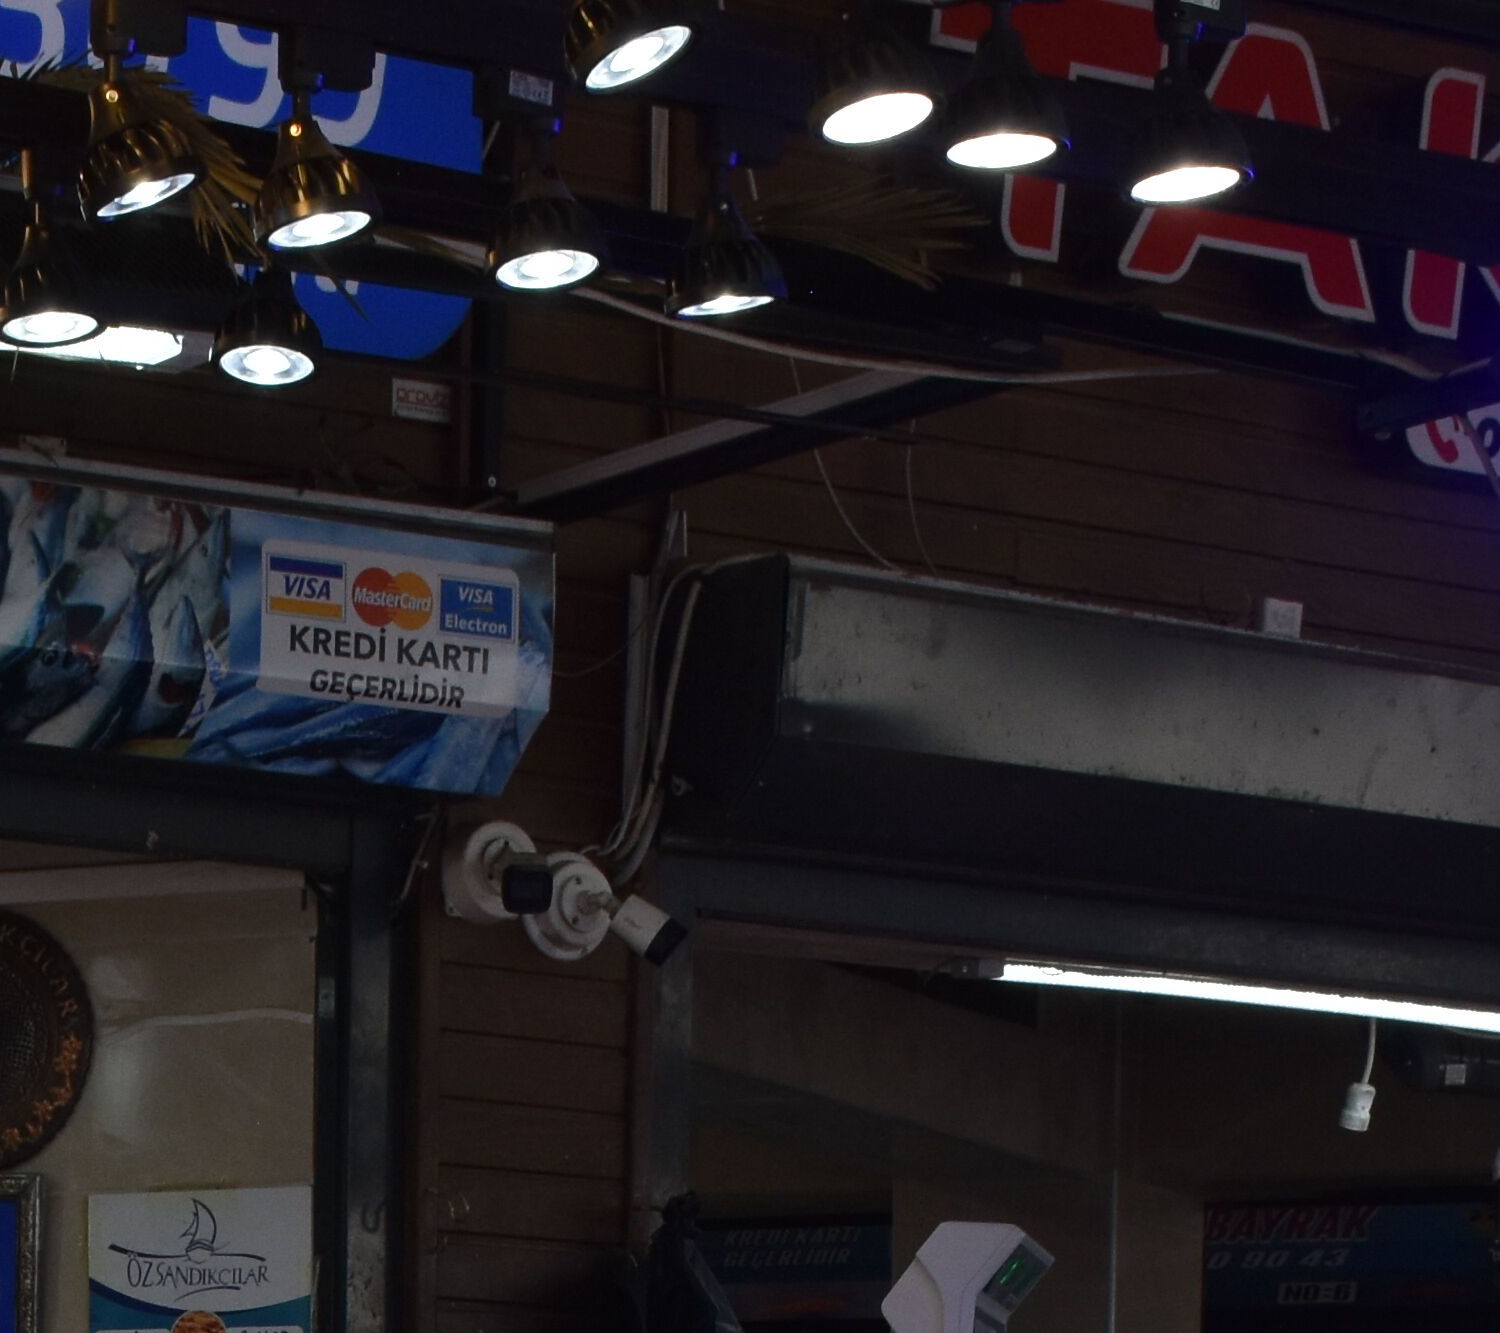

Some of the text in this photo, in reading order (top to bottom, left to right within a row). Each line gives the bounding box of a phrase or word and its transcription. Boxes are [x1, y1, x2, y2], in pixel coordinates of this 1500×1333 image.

[283, 574, 494, 612] VISA MasterCard VISA
[444, 614, 508, 635] Electron
[289, 623, 490, 674] KREDİ KARTI
[309, 668, 465, 709] GEÇERLİDİR
[126, 1251, 154, 1288] ÖZ
